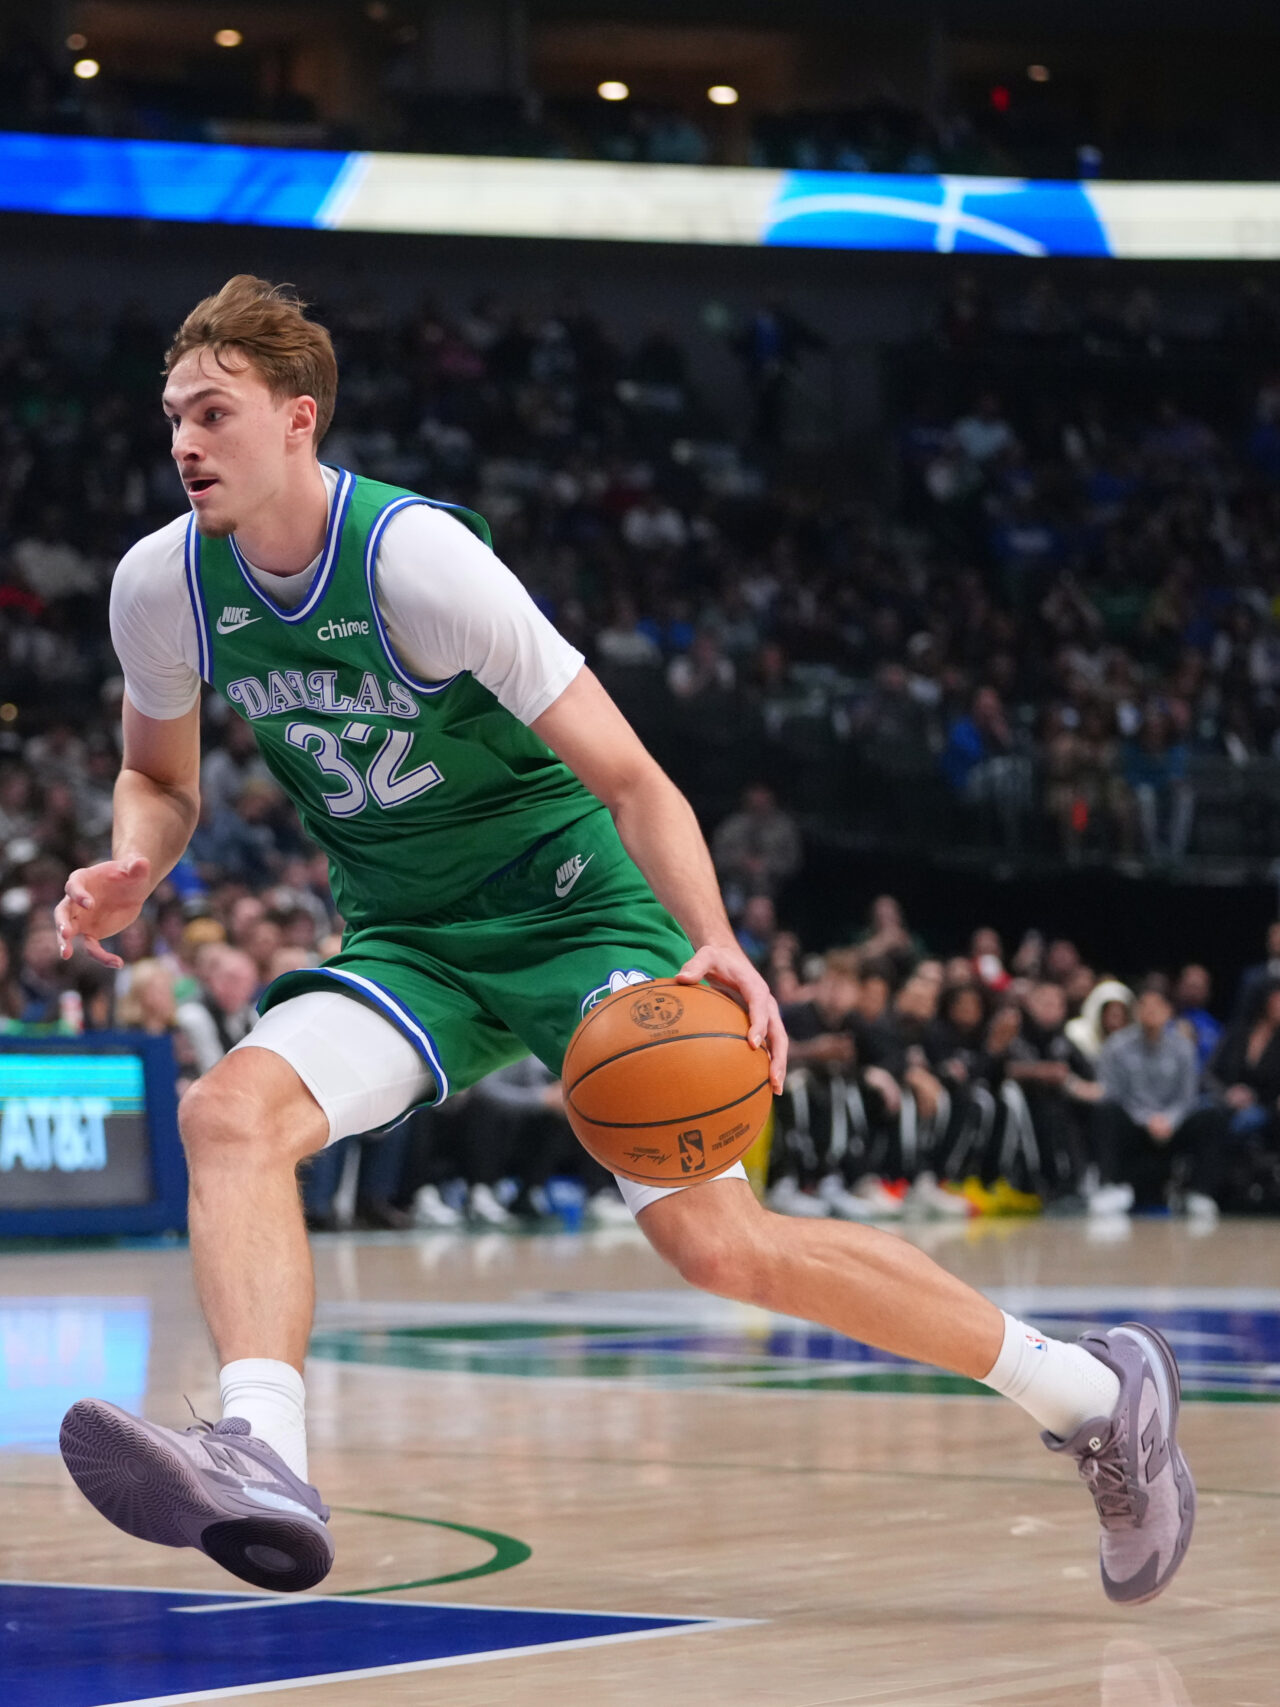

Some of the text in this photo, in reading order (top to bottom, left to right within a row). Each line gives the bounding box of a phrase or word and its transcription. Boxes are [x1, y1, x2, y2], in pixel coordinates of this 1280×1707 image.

[221, 606, 251, 623] NIKE
[317, 617, 370, 641] chime
[226, 669, 421, 720] DALLAS
[284, 721, 446, 818] 32
[556, 853, 582, 887] NIKE
